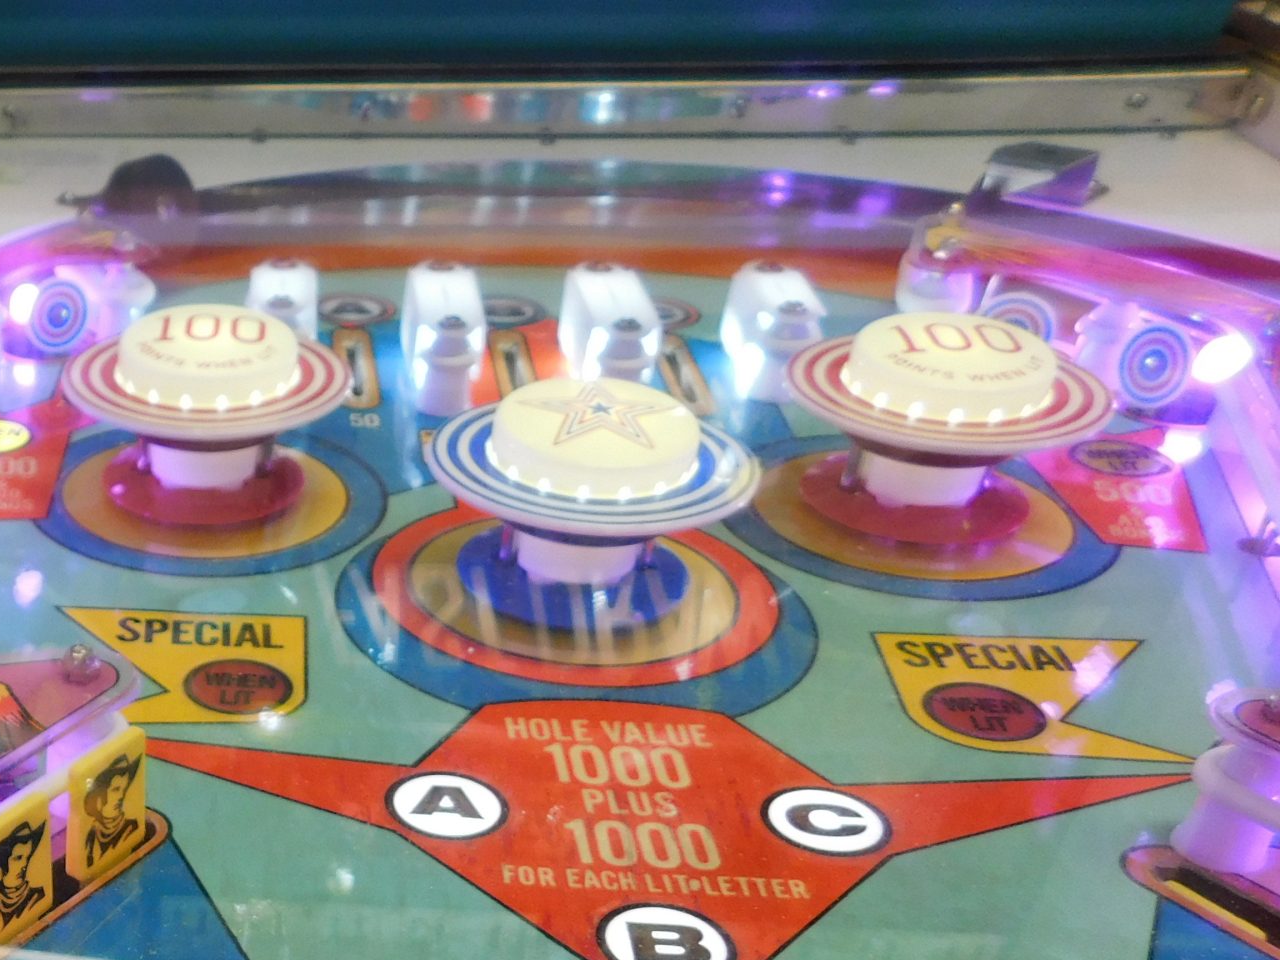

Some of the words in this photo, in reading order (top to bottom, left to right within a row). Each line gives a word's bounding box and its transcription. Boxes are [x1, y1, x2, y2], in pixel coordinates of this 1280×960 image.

[158, 314, 266, 343] 100
[890, 323, 1022, 353] 100
[887, 352, 954, 379] POINTS
[968, 369, 1025, 382] WHEN
[349, 413, 381, 427] 50
[1094, 479, 1172, 506] 500
[116, 617, 285, 649] SPECIAL
[204, 672, 276, 689] WHEN
[220, 690, 254, 705] LIT
[942, 697, 1024, 714] WHEN
[503, 717, 593, 742] HOLE
[601, 720, 713, 748] VALUE
[971, 714, 1009, 733] LIT
[542, 744, 693, 789] 1000
[409, 785, 484, 820] A
[582, 789, 679, 818] PLUS
[786, 803, 868, 837] C
[564, 819, 722, 870] 1000
[502, 863, 557, 888] FOR
[567, 866, 637, 893] EACH
